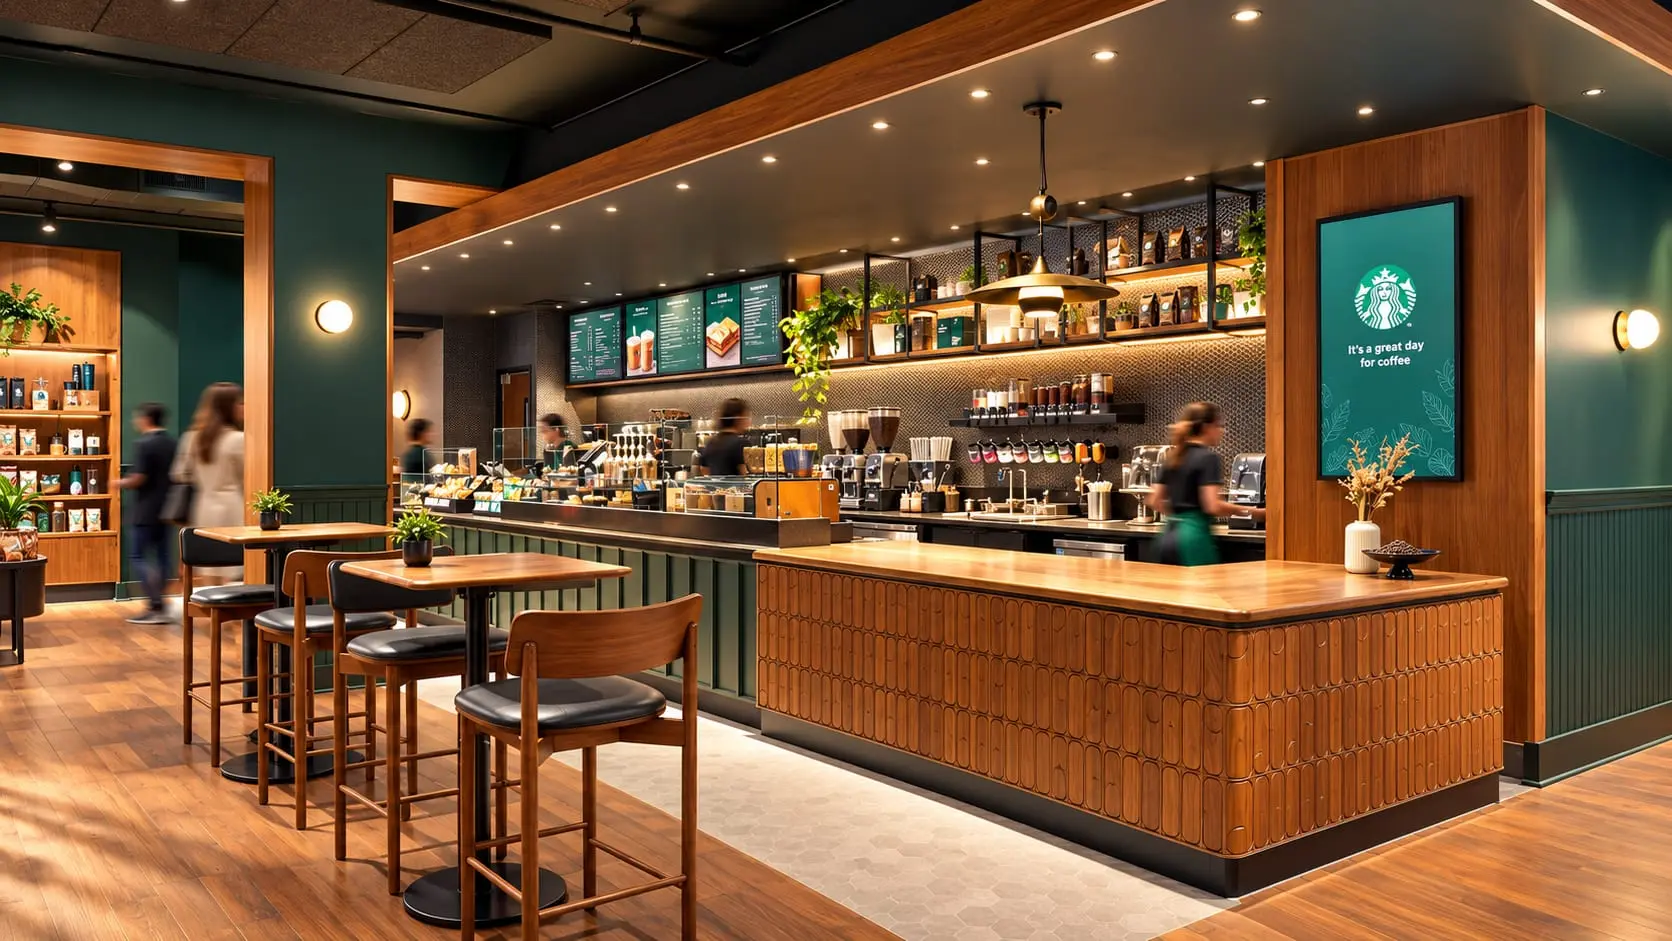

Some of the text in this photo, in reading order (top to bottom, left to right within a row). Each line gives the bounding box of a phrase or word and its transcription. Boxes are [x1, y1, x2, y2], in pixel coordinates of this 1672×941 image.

[1348, 340, 1424, 355] It's a great day
[1360, 355, 1411, 368] for coffee
